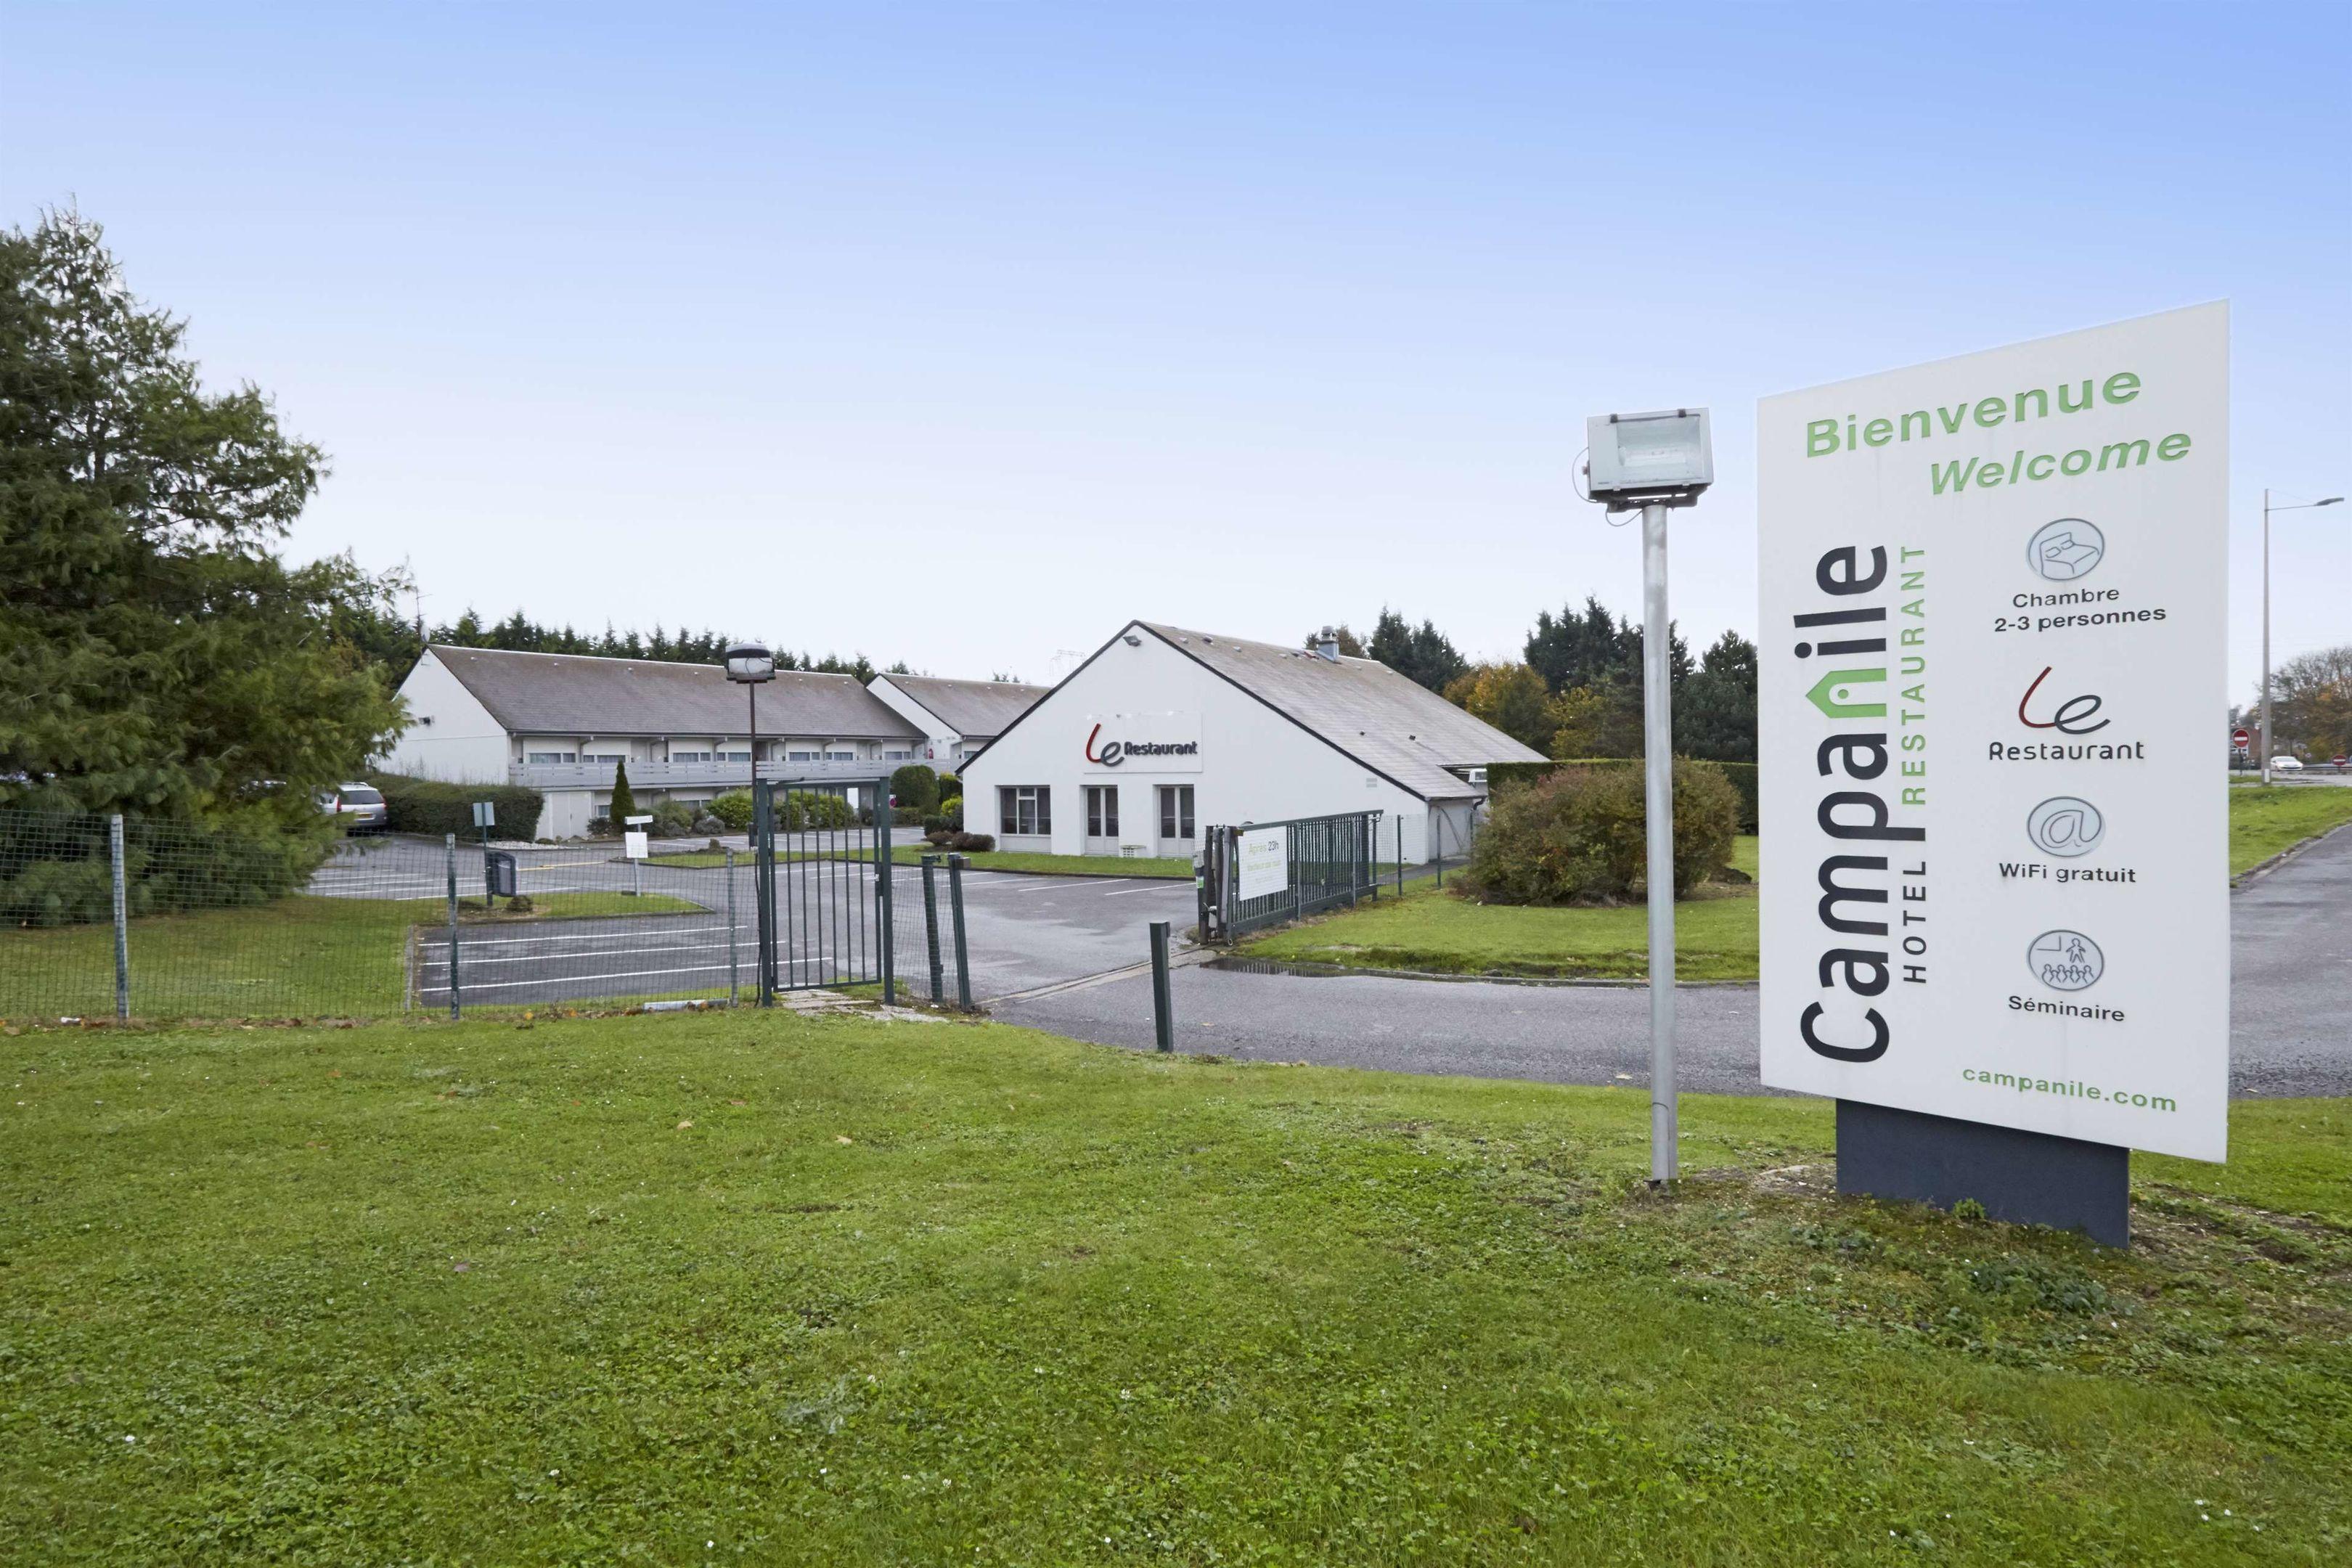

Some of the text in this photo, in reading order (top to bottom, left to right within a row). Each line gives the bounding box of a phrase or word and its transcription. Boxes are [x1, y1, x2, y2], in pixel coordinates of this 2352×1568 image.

[1807, 372, 2142, 459] Bienvenue
[1931, 432, 2191, 496] Welcome
[2012, 588, 2120, 609] Chambre
[1994, 608, 2167, 634] 2-3 personnes
[1124, 740, 1199, 756] Restaurant
[1988, 741, 2146, 762] Restaurant
[1900, 546, 1928, 985] HOTEL RESTAURANT
[1793, 546, 1927, 1063] Campanile
[1267, 840, 1279, 851] 23h
[1998, 862, 2138, 884] WiFi gratuit
[2008, 995, 2127, 1023] Séminaire
[1961, 1067, 2179, 1114] campanile.com
